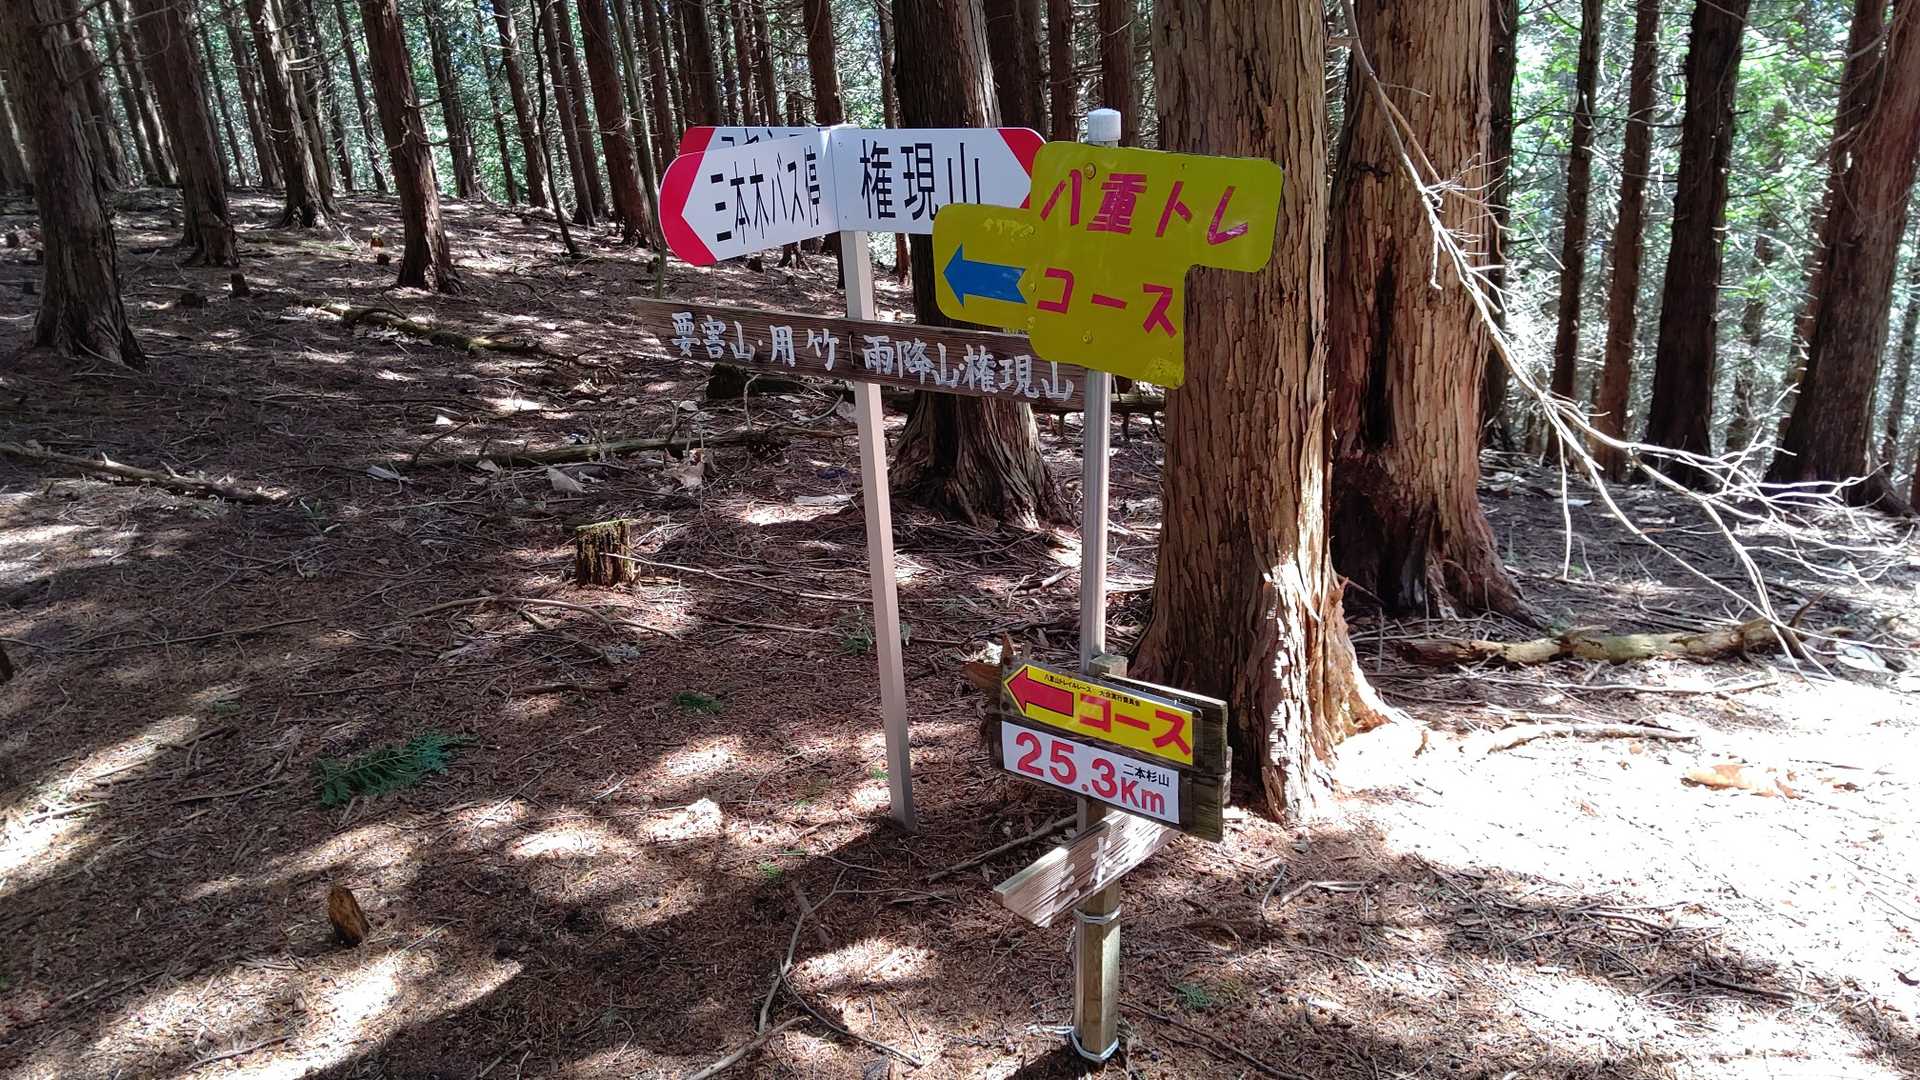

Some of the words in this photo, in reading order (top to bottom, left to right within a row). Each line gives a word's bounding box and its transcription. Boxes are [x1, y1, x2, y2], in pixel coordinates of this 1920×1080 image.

[711, 145, 821, 245] 三本木バス停
[860, 139, 981, 221] 権現山
[1040, 168, 1249, 245] 八重トレ
[1036, 267, 1178, 338] コース
[1079, 694, 1192, 757] コース
[1122, 763, 1170, 788] 二本杉山
